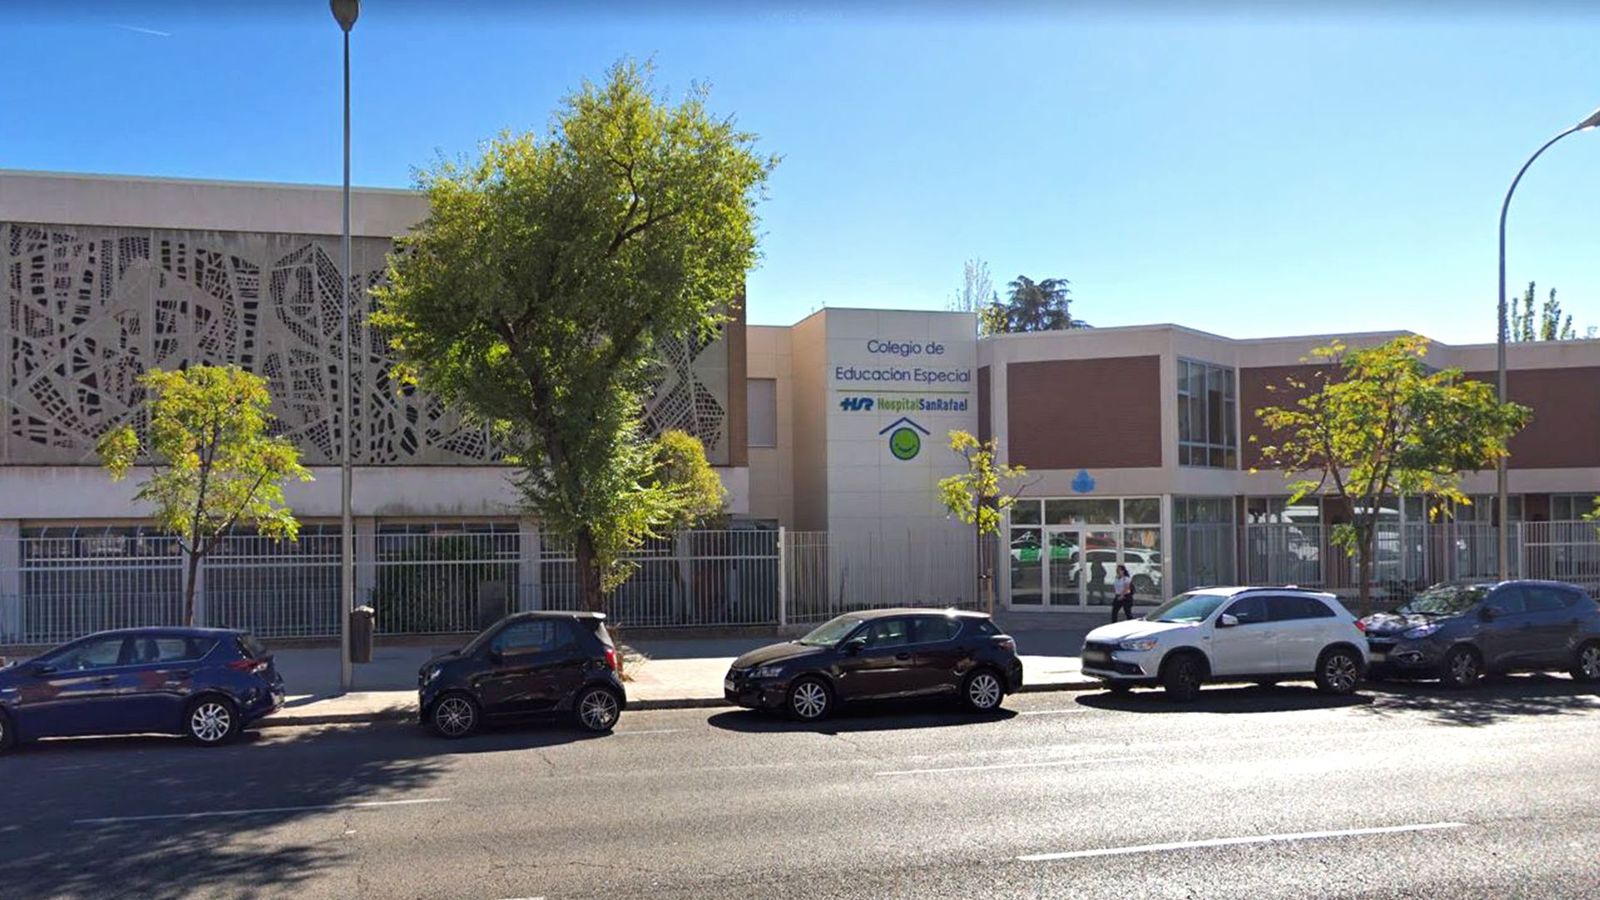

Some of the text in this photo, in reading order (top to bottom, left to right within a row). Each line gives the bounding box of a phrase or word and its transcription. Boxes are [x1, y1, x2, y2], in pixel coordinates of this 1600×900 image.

[867, 339, 944, 357] Colegio de
[914, 368, 971, 384] Especial
